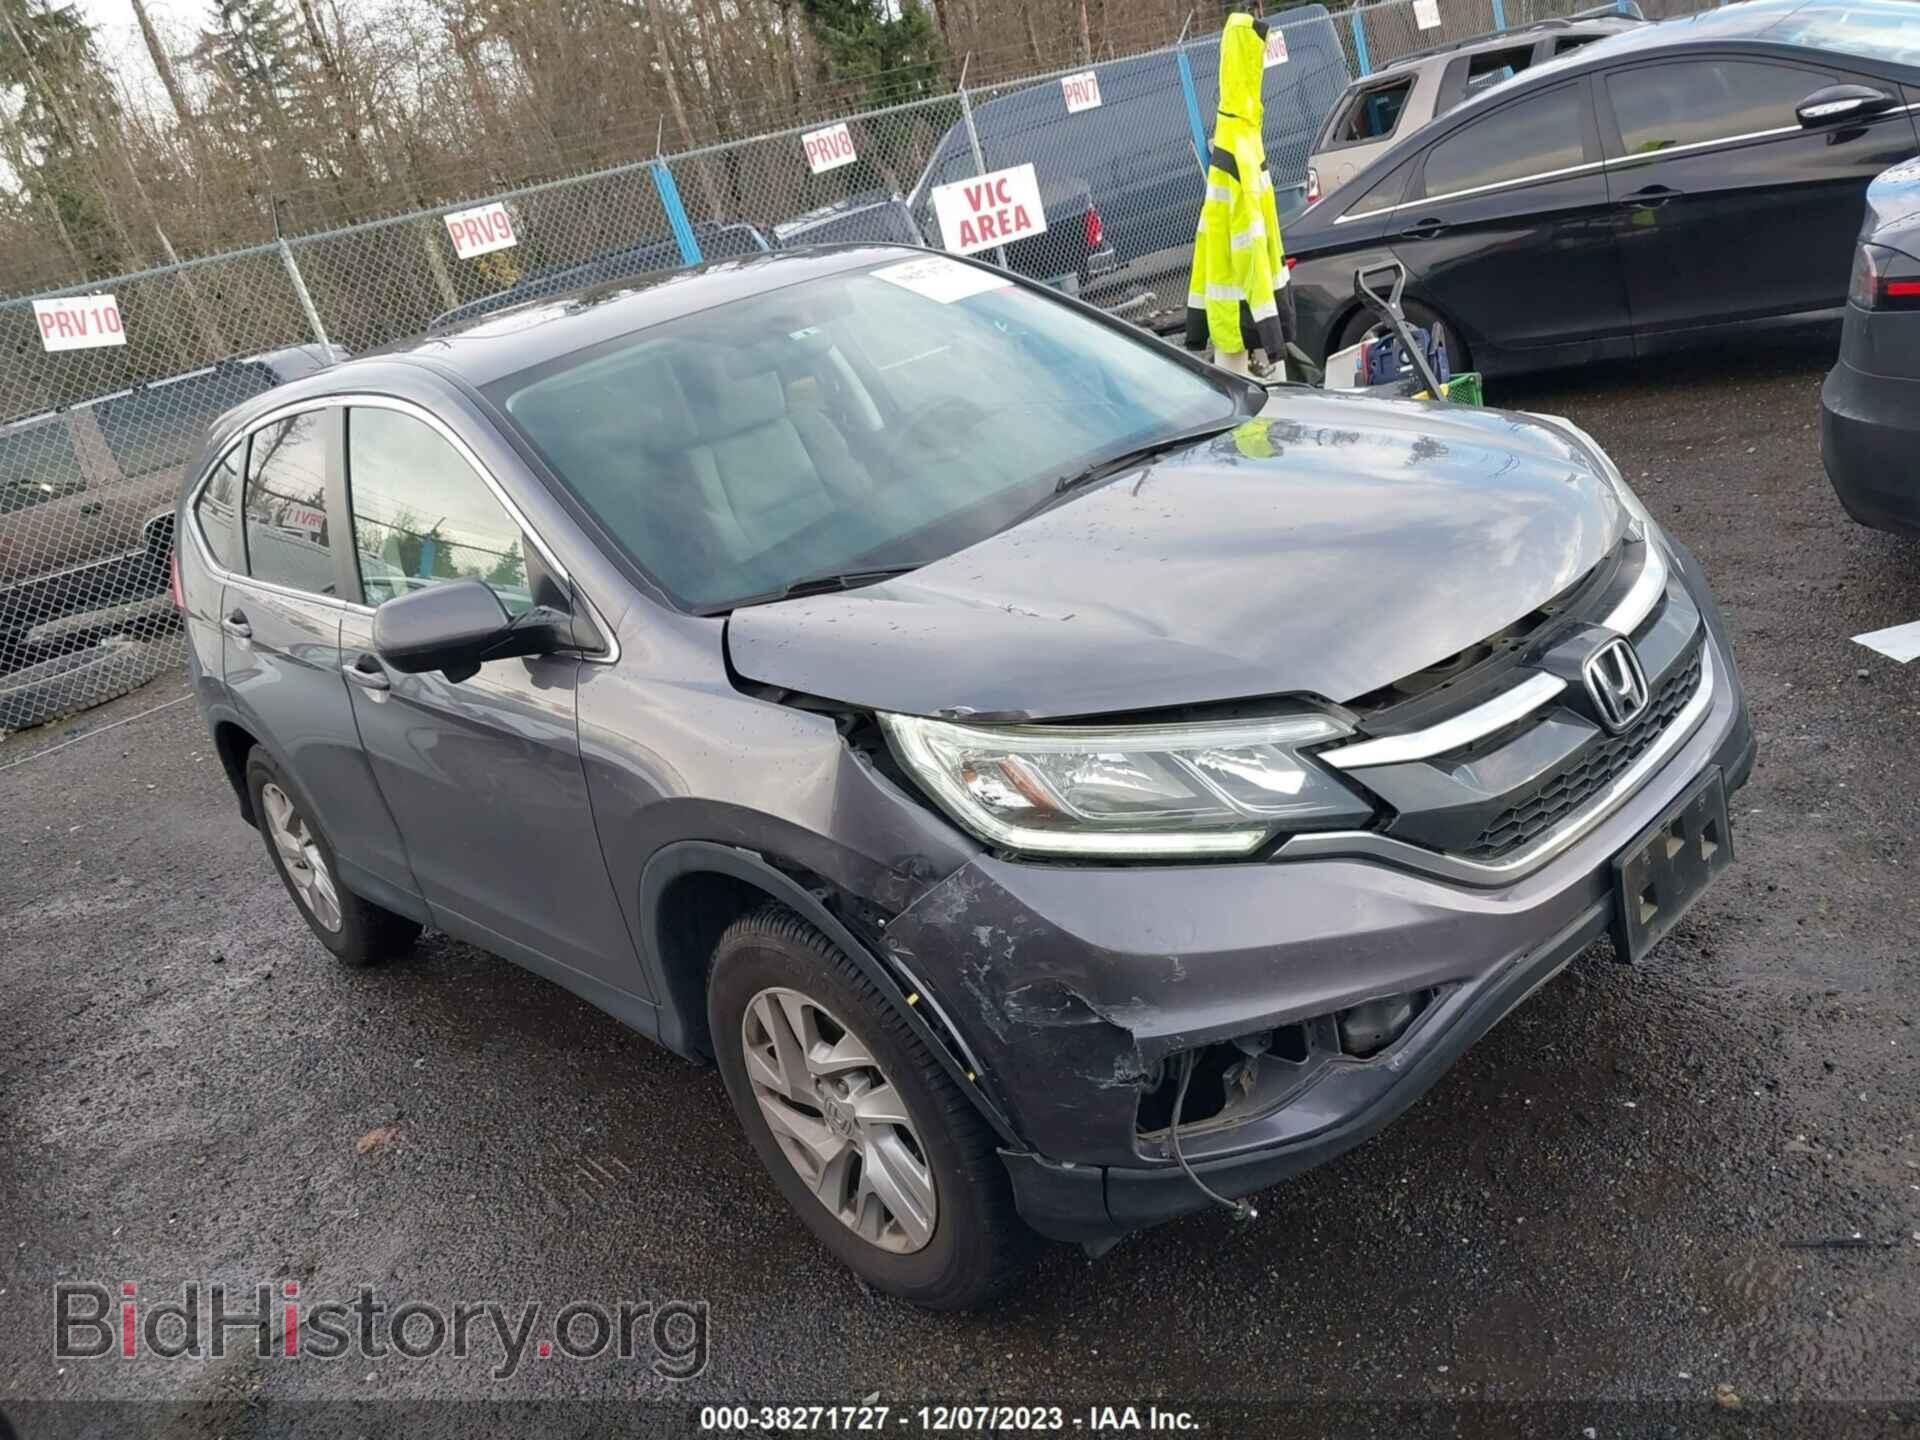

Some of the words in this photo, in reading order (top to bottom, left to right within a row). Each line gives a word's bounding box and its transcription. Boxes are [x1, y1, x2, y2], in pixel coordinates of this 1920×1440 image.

[1065, 79, 1097, 107] PRV7
[806, 131, 852, 167] PRV8
[964, 178, 1012, 212] VIC
[449, 211, 511, 251] PRV9
[960, 205, 1032, 248] AREA
